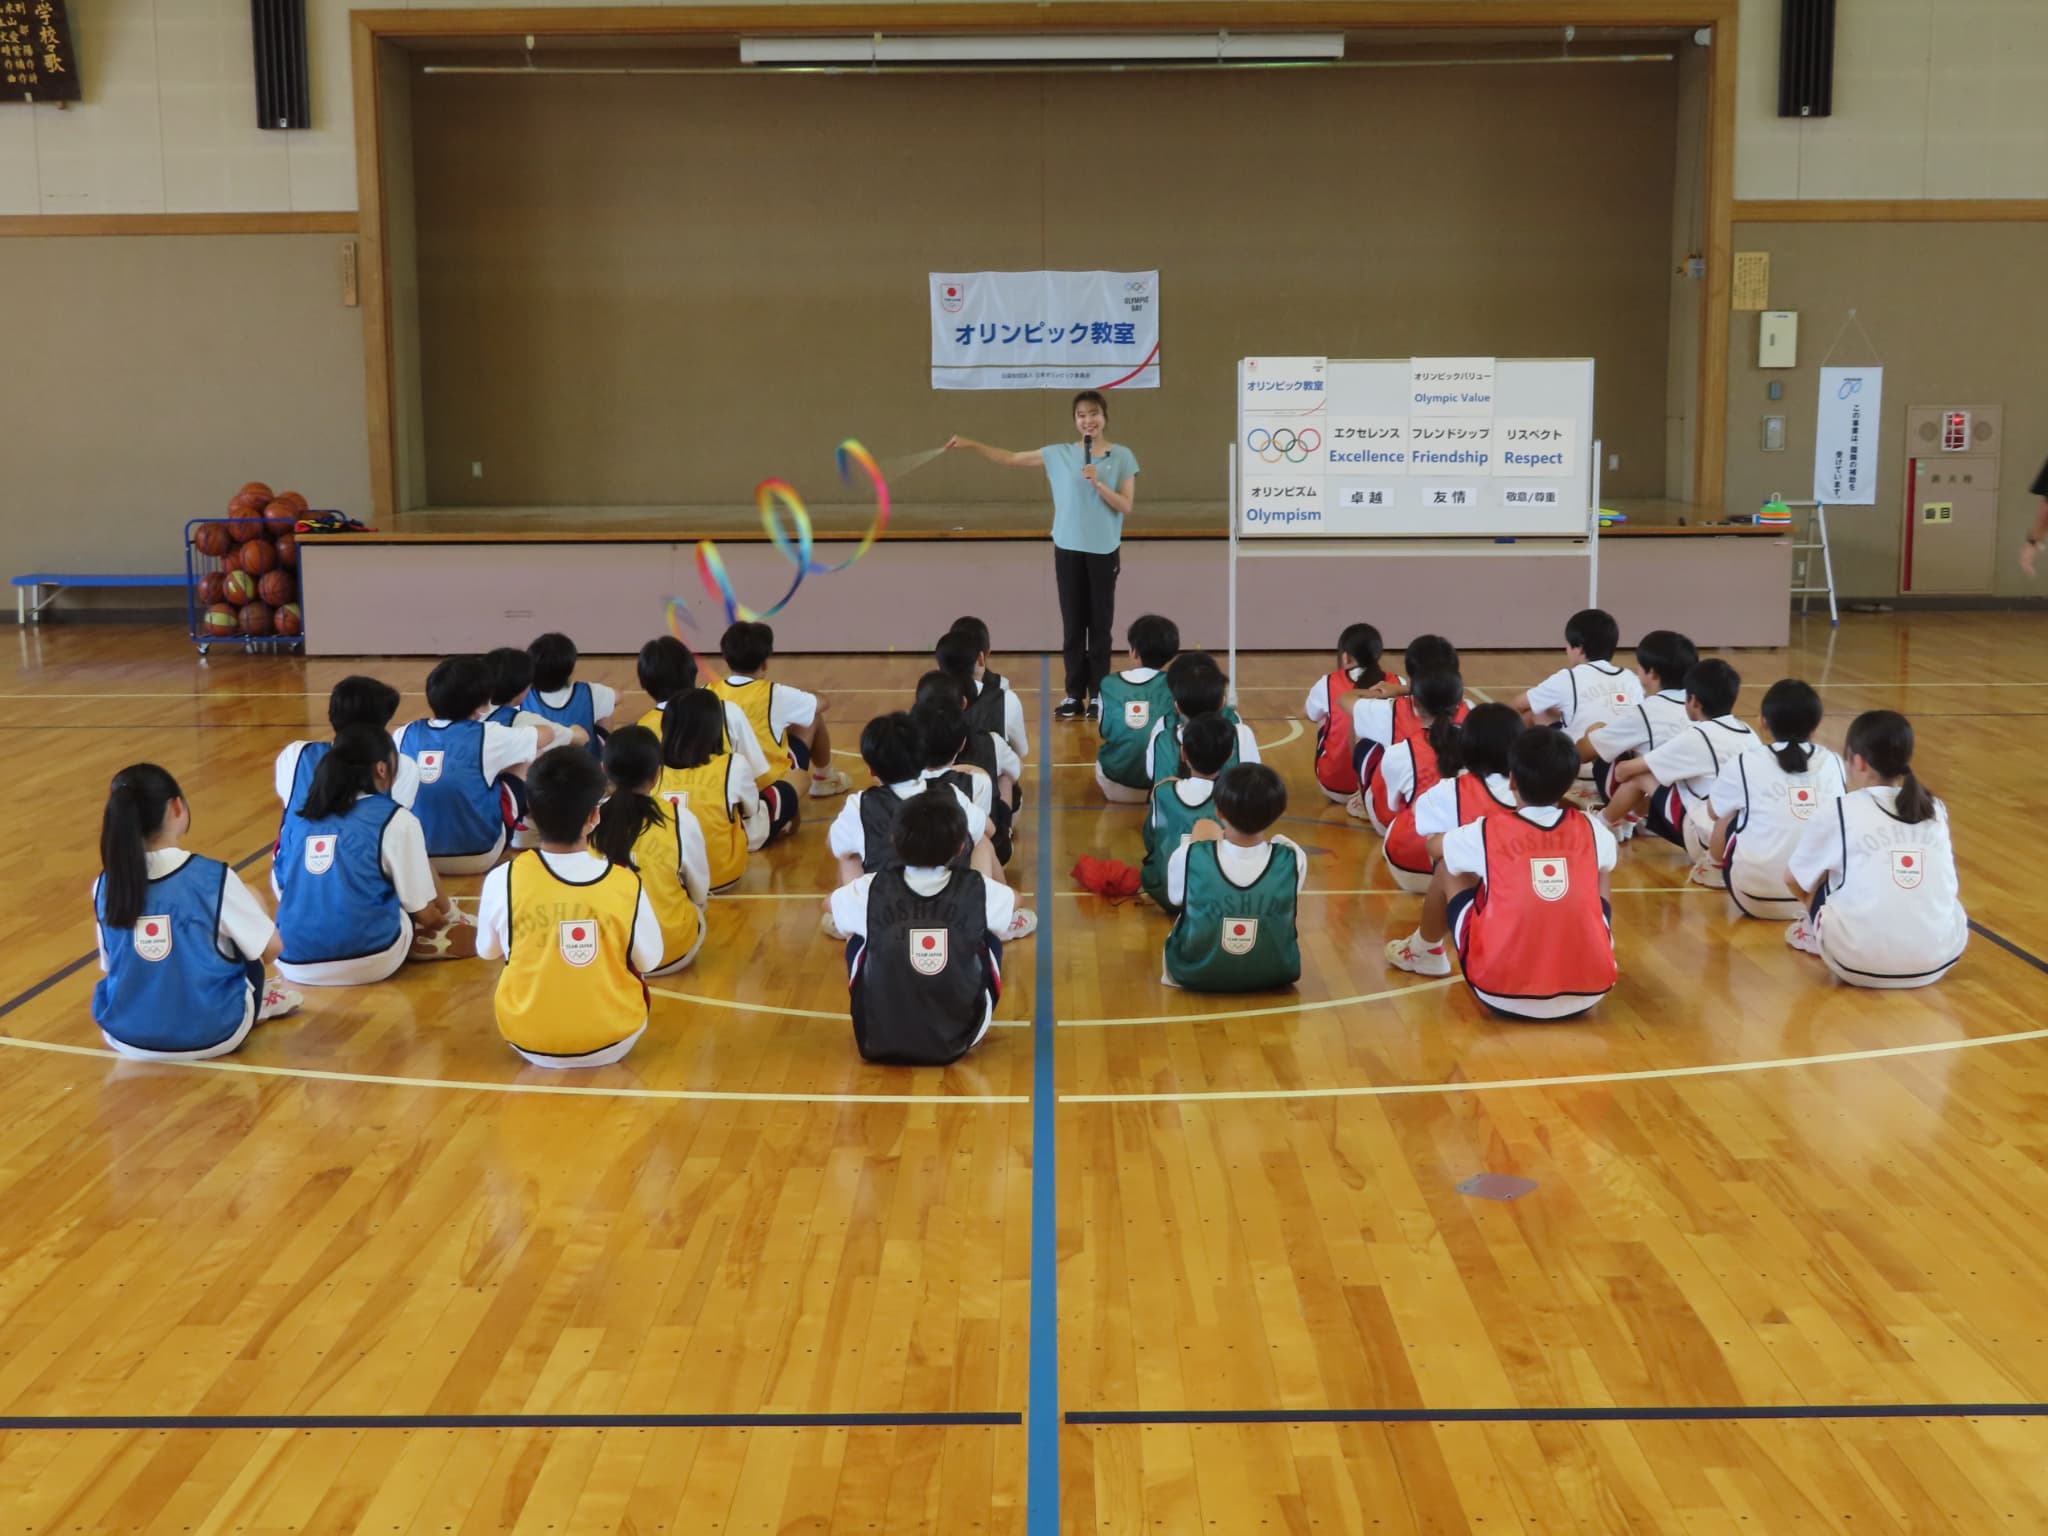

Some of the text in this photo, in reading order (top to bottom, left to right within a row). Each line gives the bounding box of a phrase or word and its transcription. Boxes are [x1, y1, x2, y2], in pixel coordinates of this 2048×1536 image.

[955, 321, 1136, 346] オリンピック教室
[1414, 372, 1491, 381] オリンピックバリュー
[1247, 380, 1324, 391] オリンピック教室
[1414, 393, 1491, 405] Olympic Value
[1334, 427, 1400, 440] エクセレンス
[1412, 427, 1490, 440] フレンドシップ
[1506, 429, 1563, 440] リスペクト
[1329, 450, 1405, 463] Excellence
[1412, 450, 1489, 467] Friendship
[1504, 451, 1563, 468] Respect
[1251, 486, 1317, 497] オリンピズム
[1433, 490, 1466, 504] 友情
[1246, 508, 1322, 525] Olympism
